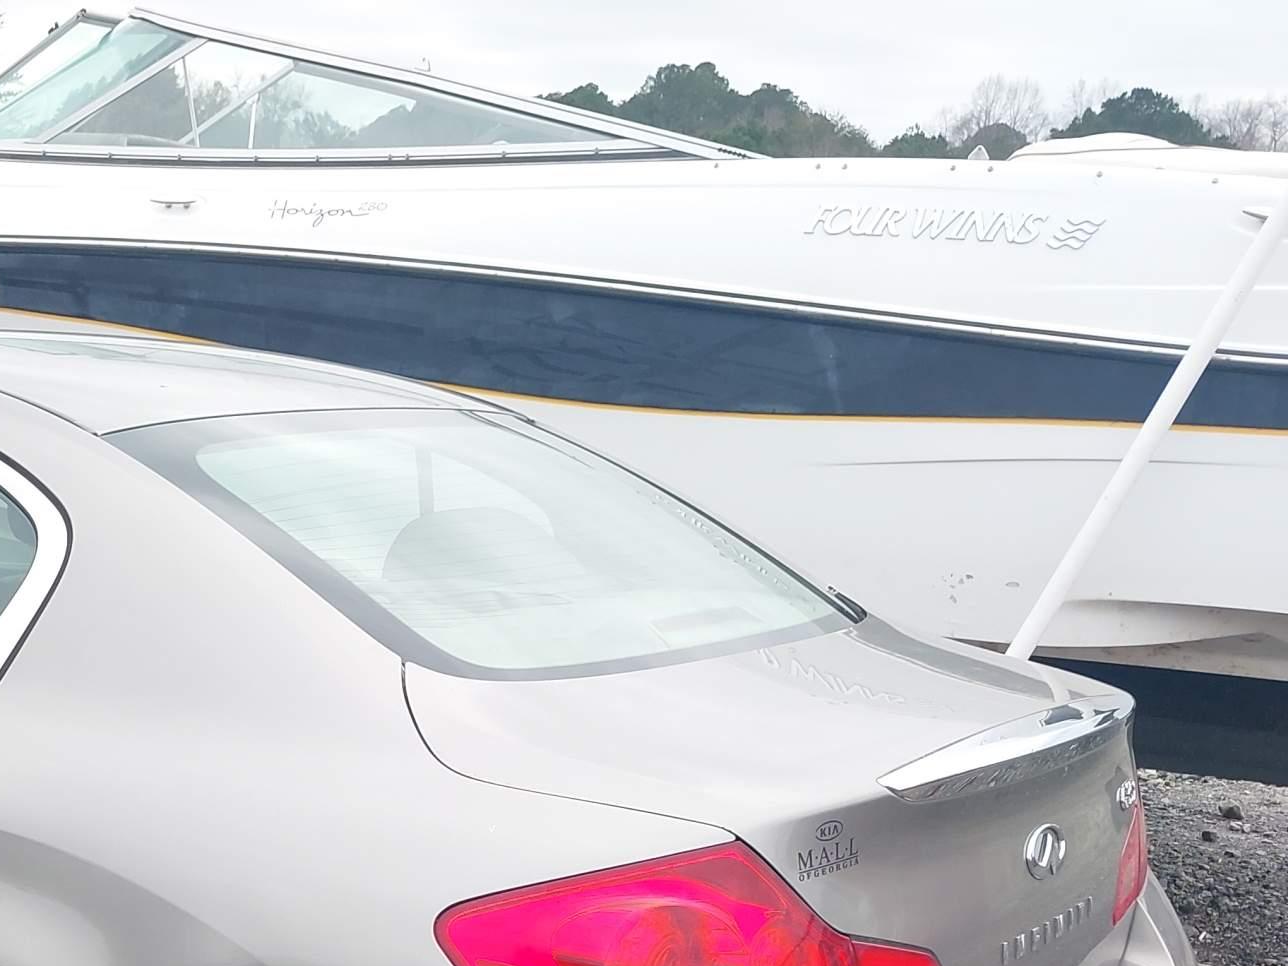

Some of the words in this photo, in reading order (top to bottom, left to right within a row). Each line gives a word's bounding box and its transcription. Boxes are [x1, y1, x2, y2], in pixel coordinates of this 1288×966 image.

[268, 199, 369, 228] Horizon
[803, 203, 908, 238] FOUR
[910, 206, 1049, 245] WINNS
[819, 823, 840, 838] KIA
